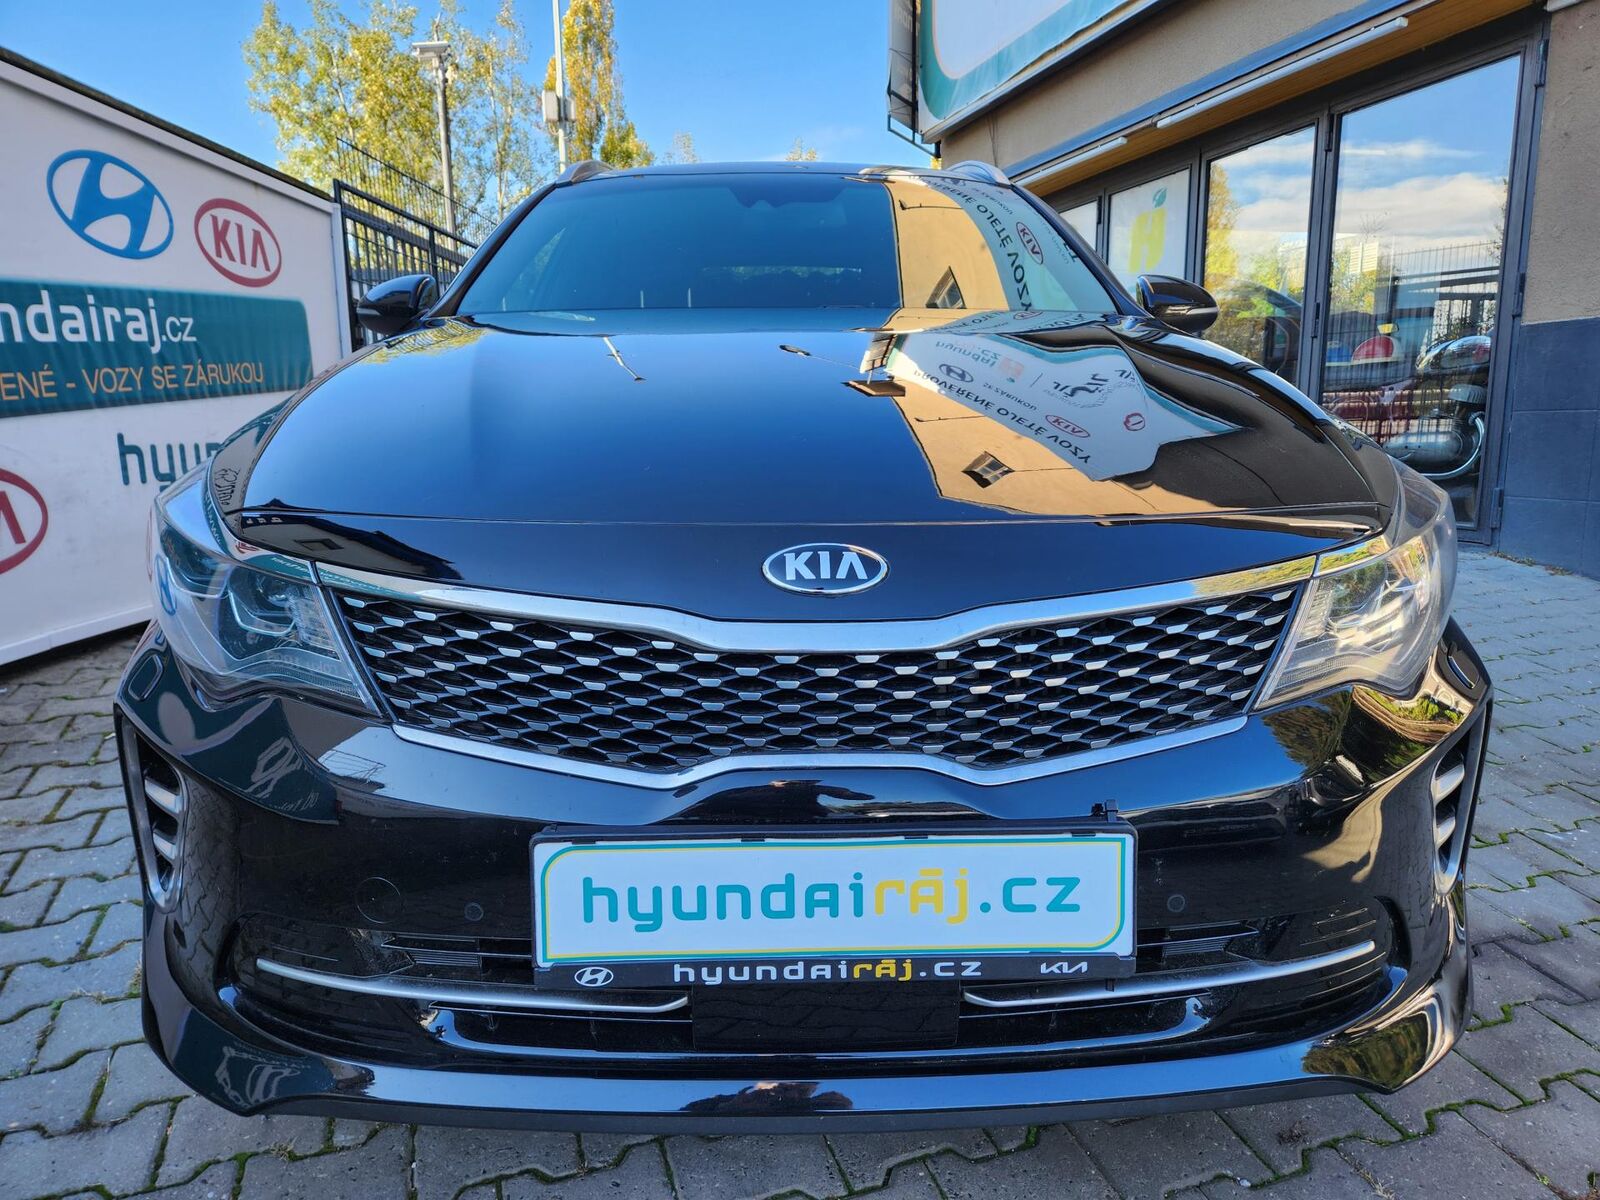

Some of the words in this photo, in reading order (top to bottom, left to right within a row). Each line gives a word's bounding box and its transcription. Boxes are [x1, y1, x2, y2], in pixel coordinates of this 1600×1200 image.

[209, 213, 271, 273] KIA
[82, 366, 144, 394] VOZY
[151, 365, 179, 390] SE
[182, 358, 264, 387] ZÁRUKOU
[117, 432, 222, 493] hyu
[783, 550, 868, 581] KIA
